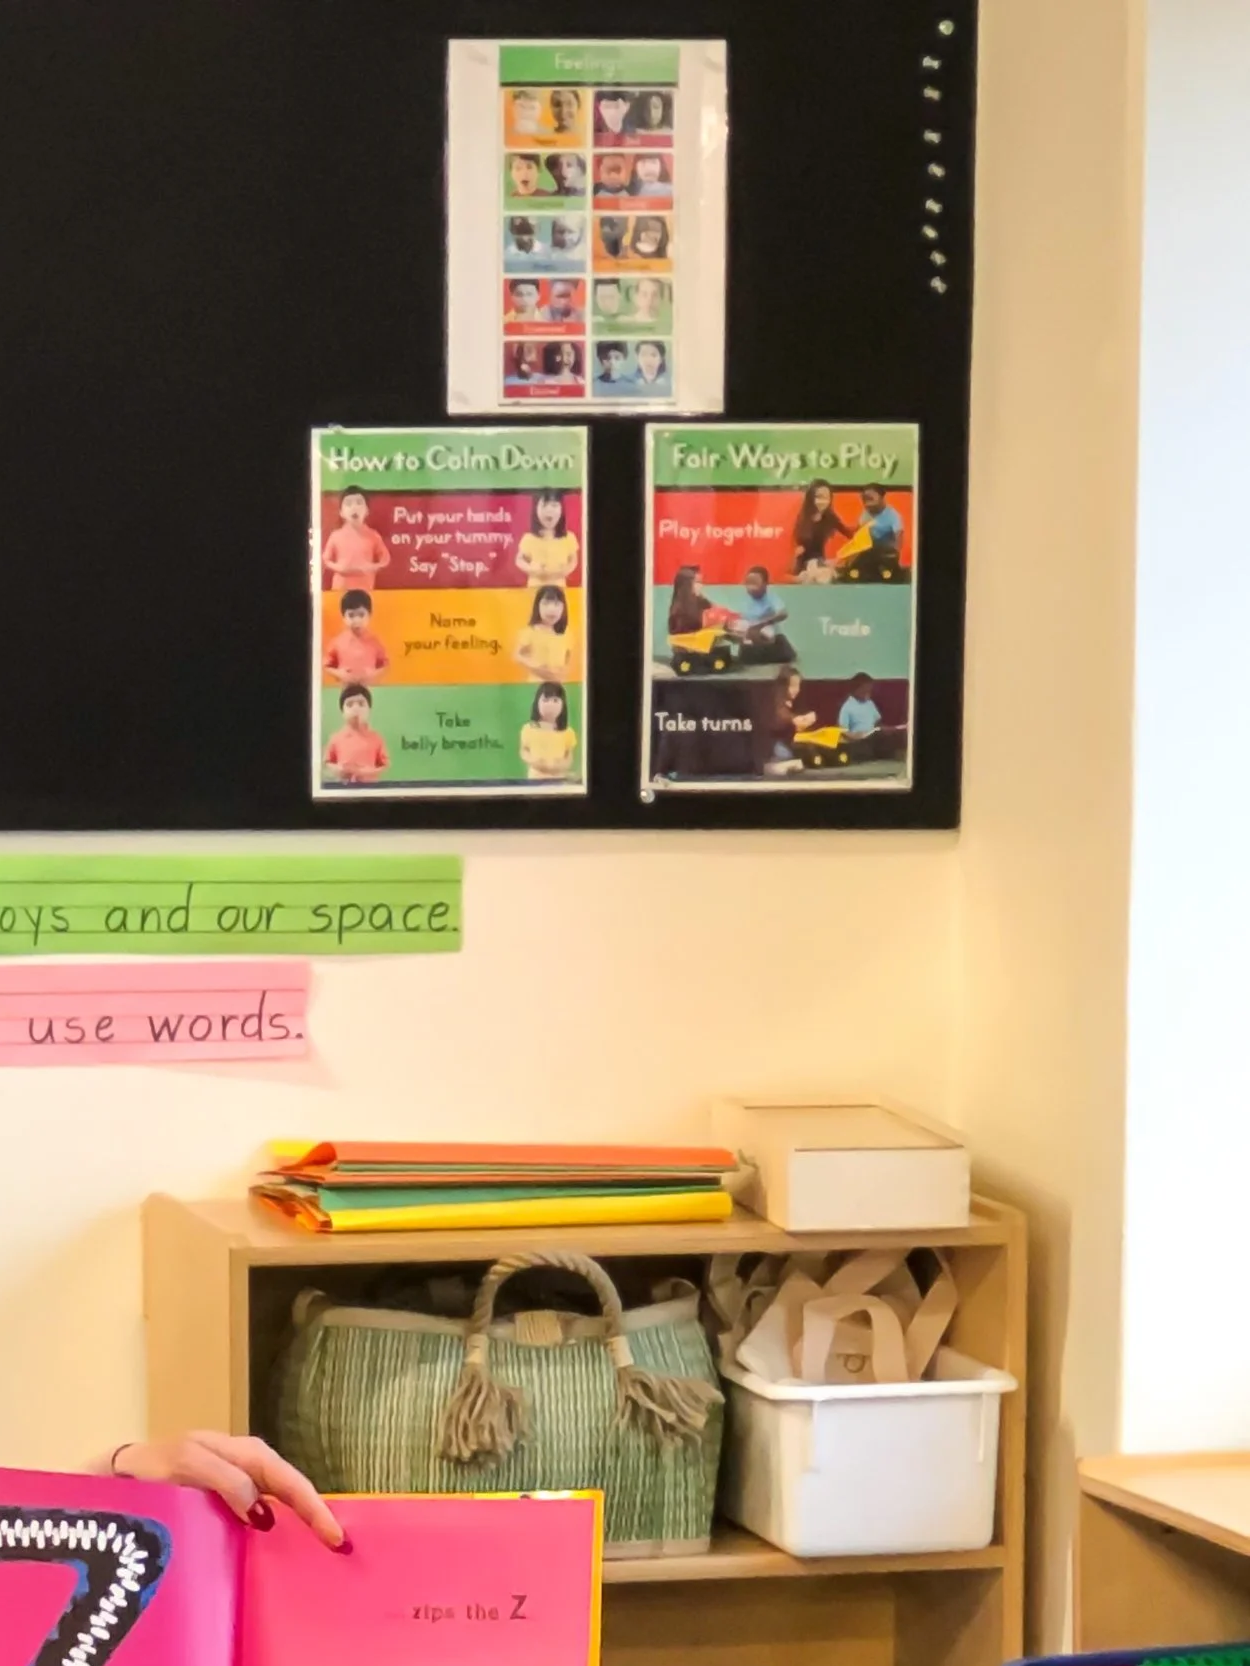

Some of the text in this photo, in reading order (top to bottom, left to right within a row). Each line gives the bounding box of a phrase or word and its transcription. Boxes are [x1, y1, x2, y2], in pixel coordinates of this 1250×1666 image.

[329, 445, 574, 472] How to Calm Down
[672, 442, 898, 478] Fair Ways to Play
[393, 506, 512, 530] Put your hands
[391, 531, 514, 550] on your tummy.
[659, 519, 784, 546] Play together
[409, 556, 437, 578] Say
[430, 613, 476, 628] Name
[819, 616, 871, 637] Trade
[404, 634, 502, 656] your feeling.
[435, 712, 471, 728] Take
[654, 711, 753, 732] Take turns
[400, 736, 438, 755] belly
[104, 881, 193, 934] and
[217, 902, 284, 933] our
[308, 900, 459, 945] space.
[28, 1014, 116, 1044] use
[147, 990, 305, 1044] words.
[466, 1603, 499, 1620] the
[509, 1594, 528, 1620] Z
